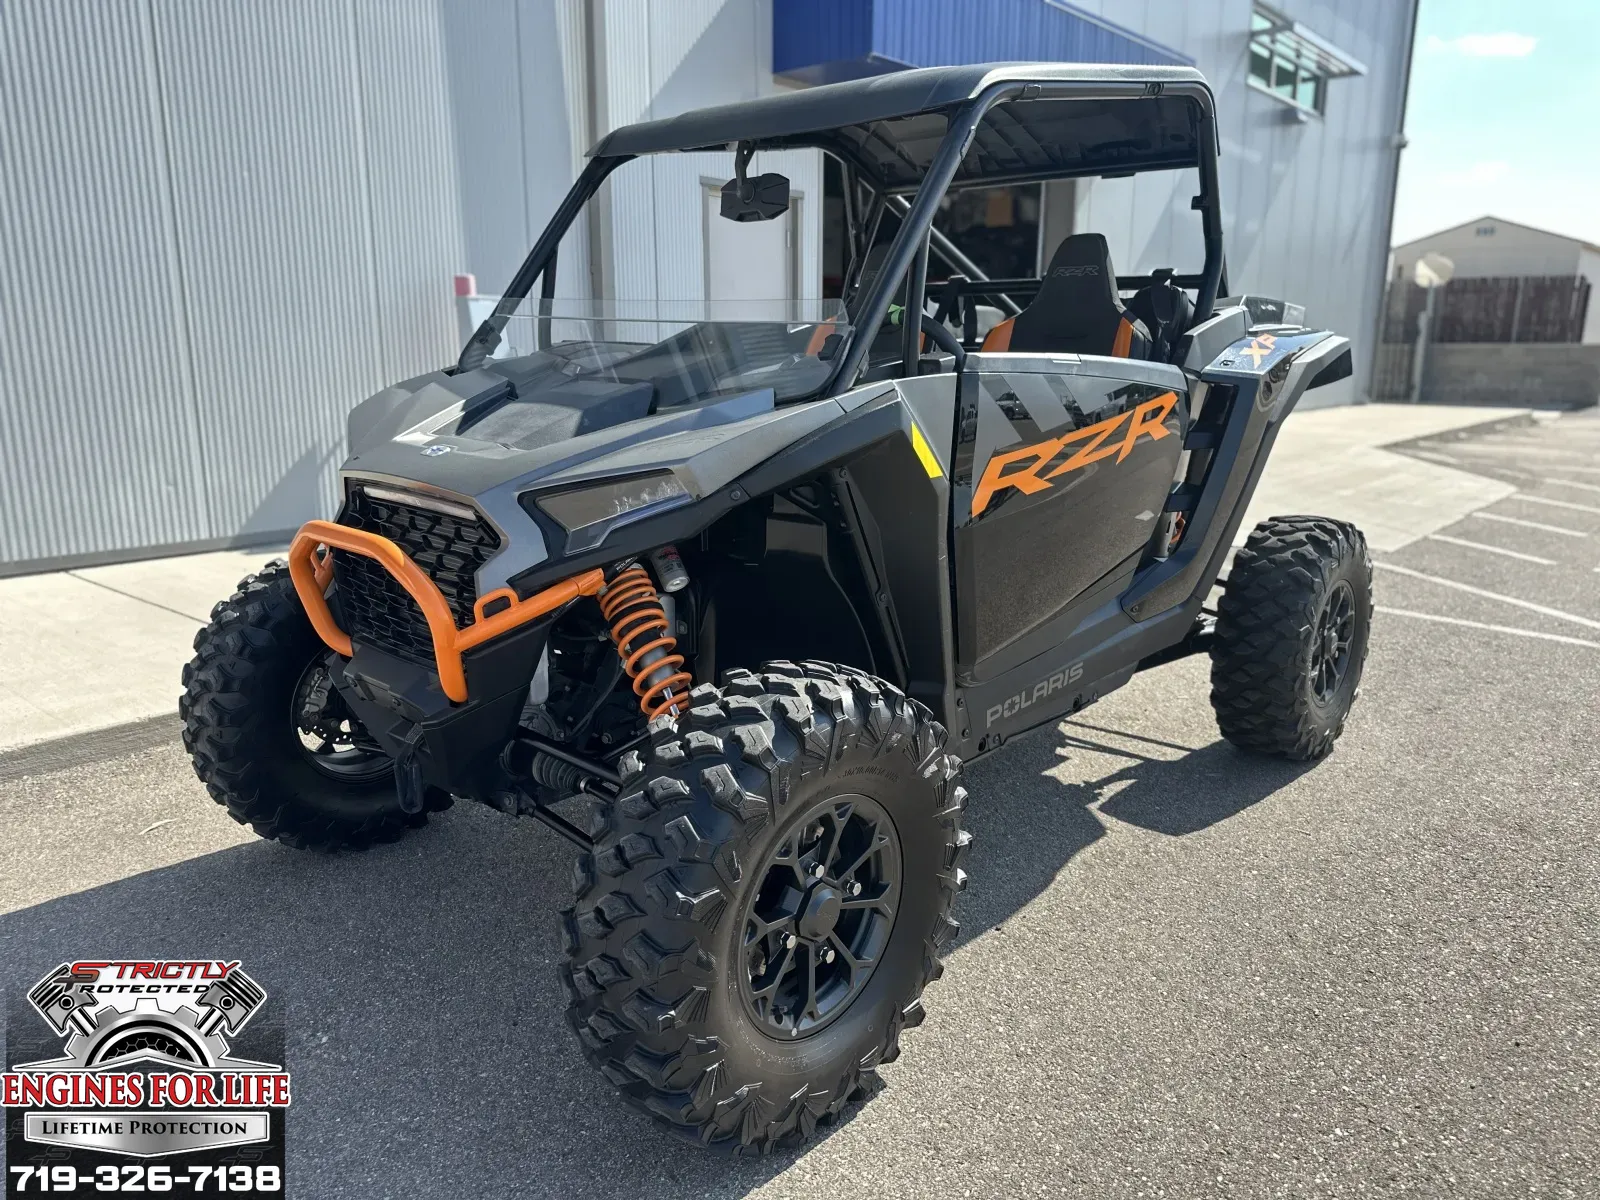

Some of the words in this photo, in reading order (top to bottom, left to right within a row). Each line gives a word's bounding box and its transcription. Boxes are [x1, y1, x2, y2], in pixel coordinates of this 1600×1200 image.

[1052, 264, 1099, 278] RZR
[1239, 333, 1278, 369] XP
[971, 391, 1178, 518] RZR
[986, 662, 1084, 729] POLARIS
